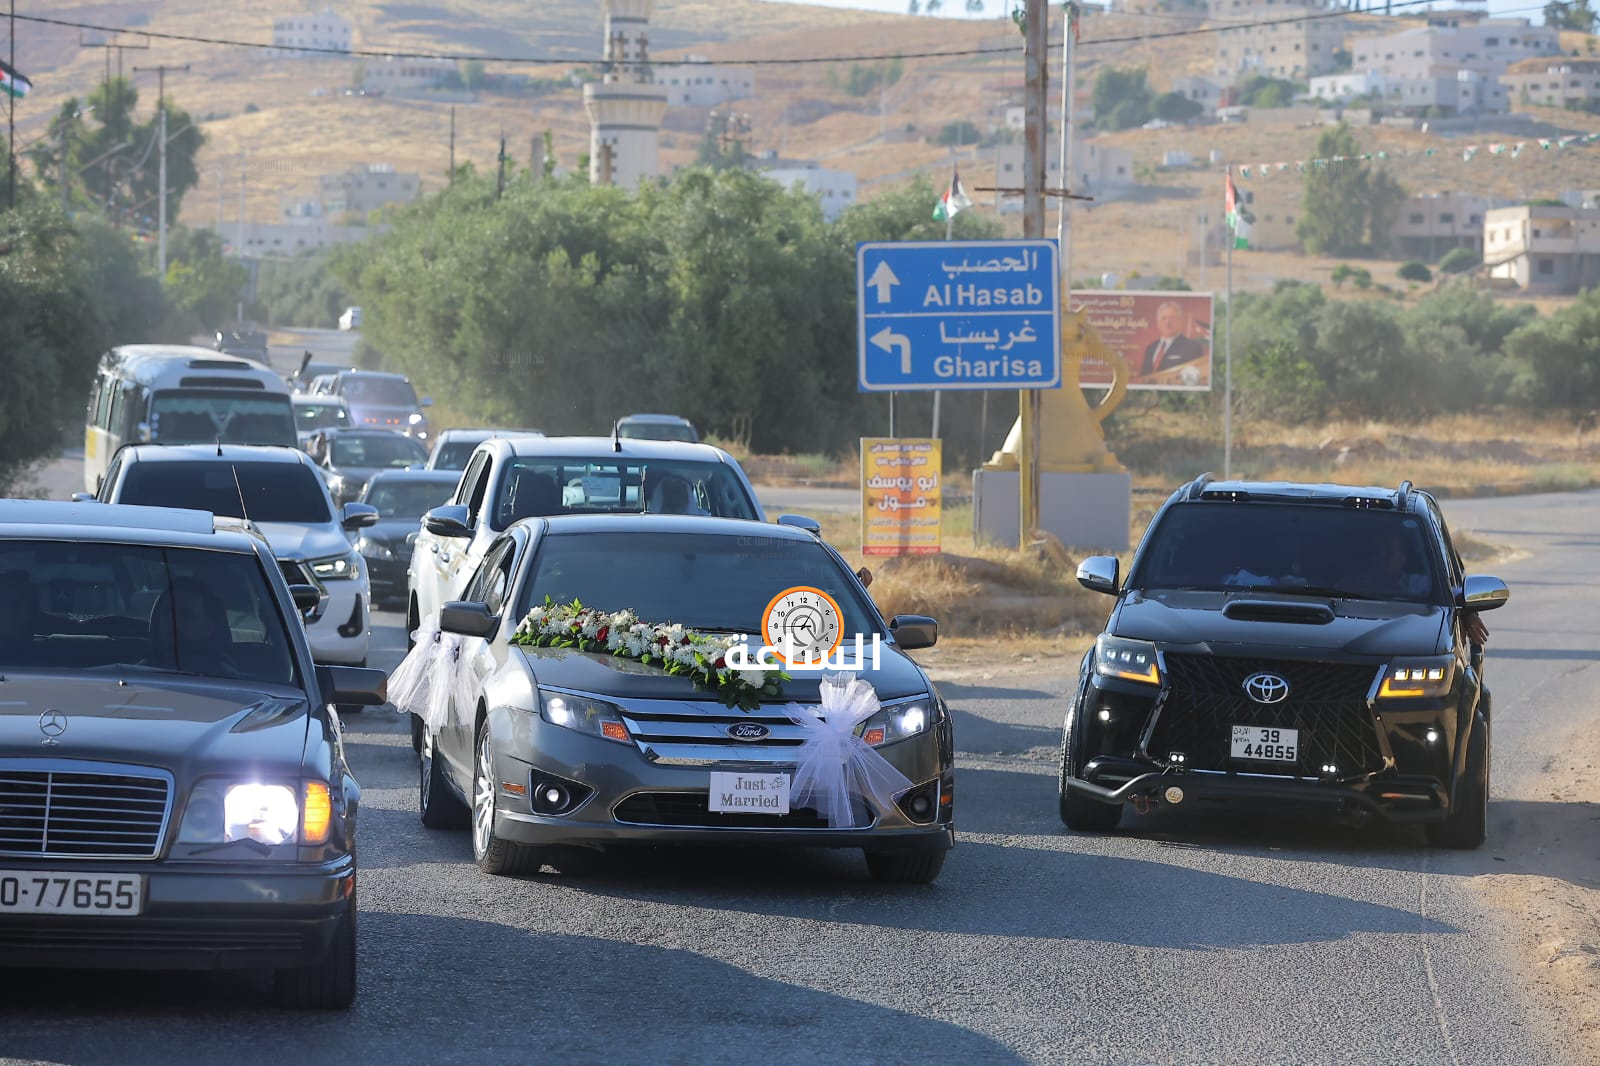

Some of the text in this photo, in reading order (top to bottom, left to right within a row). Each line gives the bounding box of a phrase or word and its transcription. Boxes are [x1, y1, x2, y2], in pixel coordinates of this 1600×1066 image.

[941, 248, 1038, 280] الحصب
[923, 283, 1043, 307] Al Hasab
[939, 319, 1038, 351] غريسا
[933, 355, 1042, 378] Gharisa
[867, 475, 914, 491] يوسف
[736, 725, 762, 736] Ford
[1260, 729, 1280, 743] 39
[1243, 743, 1295, 760] 44855
[735, 777, 766, 791] Just
[720, 793, 779, 808] Married
[0, 877, 133, 910] 0-77655
